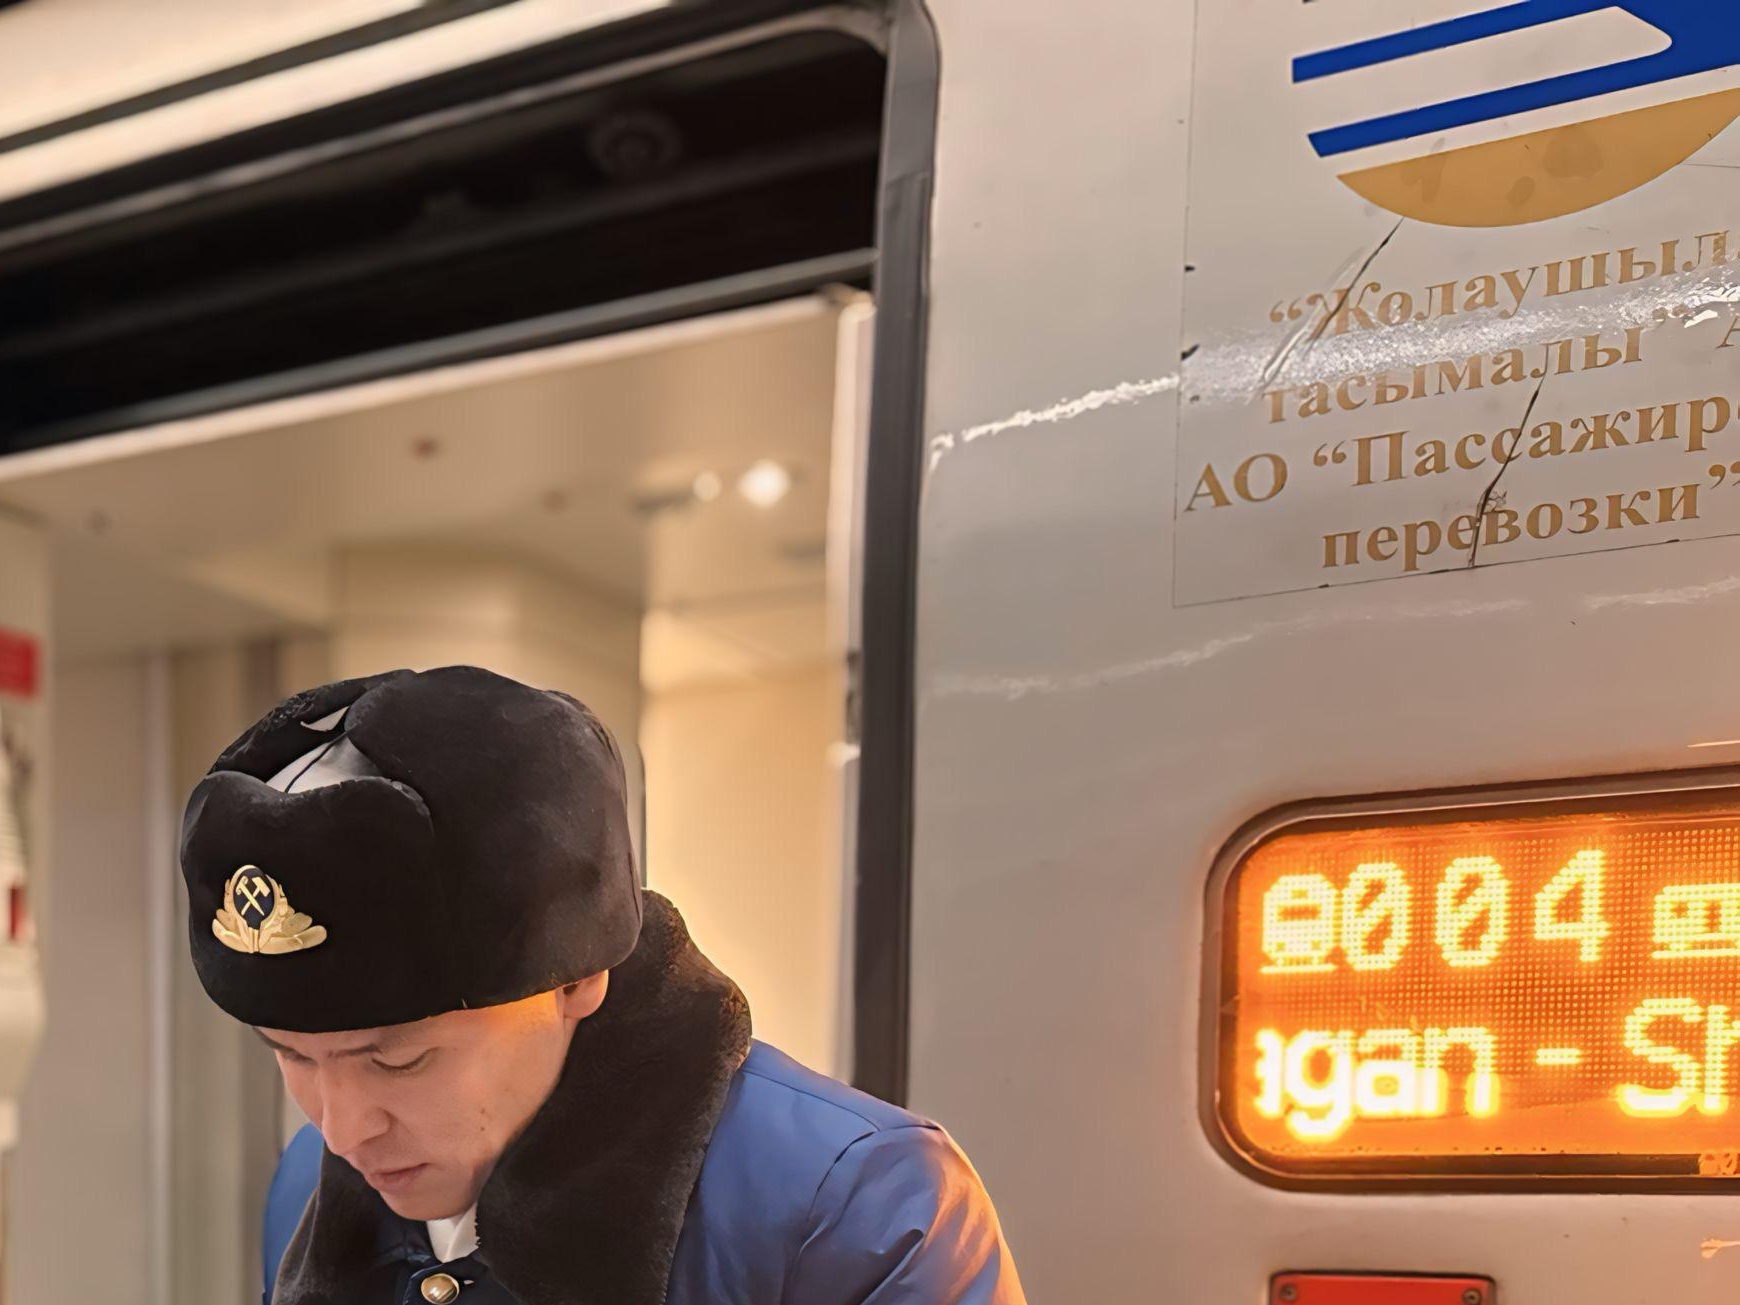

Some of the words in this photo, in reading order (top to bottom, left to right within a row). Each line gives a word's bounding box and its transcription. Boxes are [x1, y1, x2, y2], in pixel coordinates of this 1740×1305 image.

[1268, 229, 1740, 342] “Жолаушыл
[1184, 452, 1289, 513] АО
[1312, 395, 1740, 488] “Пассажир
[1322, 461, 1740, 573] перевозки”
